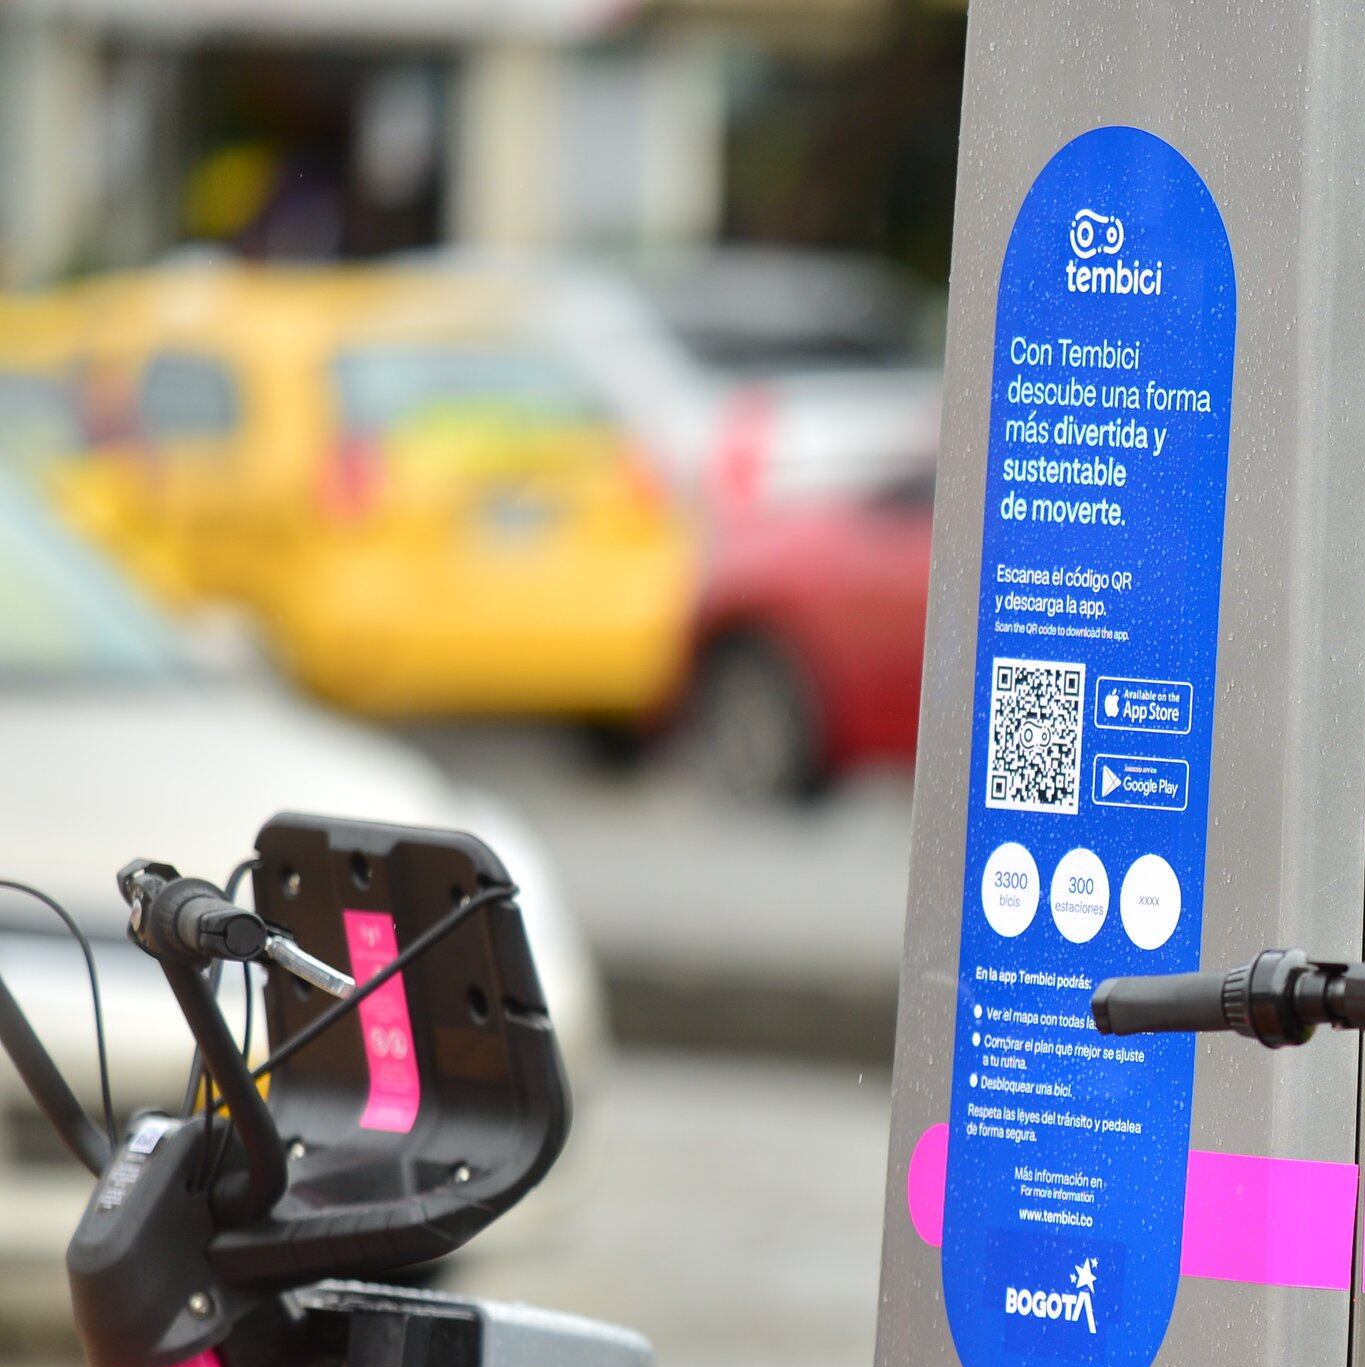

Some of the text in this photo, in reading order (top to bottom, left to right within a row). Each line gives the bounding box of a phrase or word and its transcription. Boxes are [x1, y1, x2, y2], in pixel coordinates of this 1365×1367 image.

[1065, 259, 1162, 296] tembici
[1010, 336, 1141, 370] Con Tembici
[1007, 374, 1212, 412] descube una forma
[1005, 410, 1167, 456] más divertida y
[1002, 456, 1127, 486] sustentable
[1000, 490, 1126, 526] de moverte.
[997, 564, 1132, 592] Escanea el código QR
[994, 591, 1107, 619] y descarga la app.
[994, 620, 1013, 633] Scan
[1013, 622, 1025, 634] the
[1025, 623, 1038, 635] QR
[1038, 624, 1057, 636] code
[1057, 626, 1065, 636] to
[1065, 626, 1101, 639] download
[1101, 628, 1113, 639] the
[1123, 689, 1181, 703] Available on the
[1122, 701, 1180, 723] App Store
[1123, 776, 1179, 798] Google Play
[994, 871, 1028, 890] 3300
[1068, 876, 1094, 895] 300
[999, 893, 1021, 908] bicis
[1054, 900, 1104, 916] estaciones
[976, 966, 1092, 991] En la app Tembici podrás:
[986, 1006, 1002, 1021] Ver
[1003, 1008, 1012, 1021] el
[1013, 1012, 1039, 1027] mapa
[1040, 1015, 1058, 1026] con
[1059, 1015, 1085, 1029] todas
[984, 1034, 1145, 1064] Comprar el plan que mejor se ajuste
[982, 1054, 1028, 1070] a tu rutina.
[980, 1076, 1073, 1098] Desbloquear una bici.
[967, 1103, 1142, 1134] Respeta las leyes del tránsito y pedalea
[966, 1122, 1038, 1143] de forma segura.
[1015, 1165, 1103, 1188] Más información en
[1020, 1184, 1095, 1203] For more information
[1019, 1208, 1094, 1227] www.tembici.co
